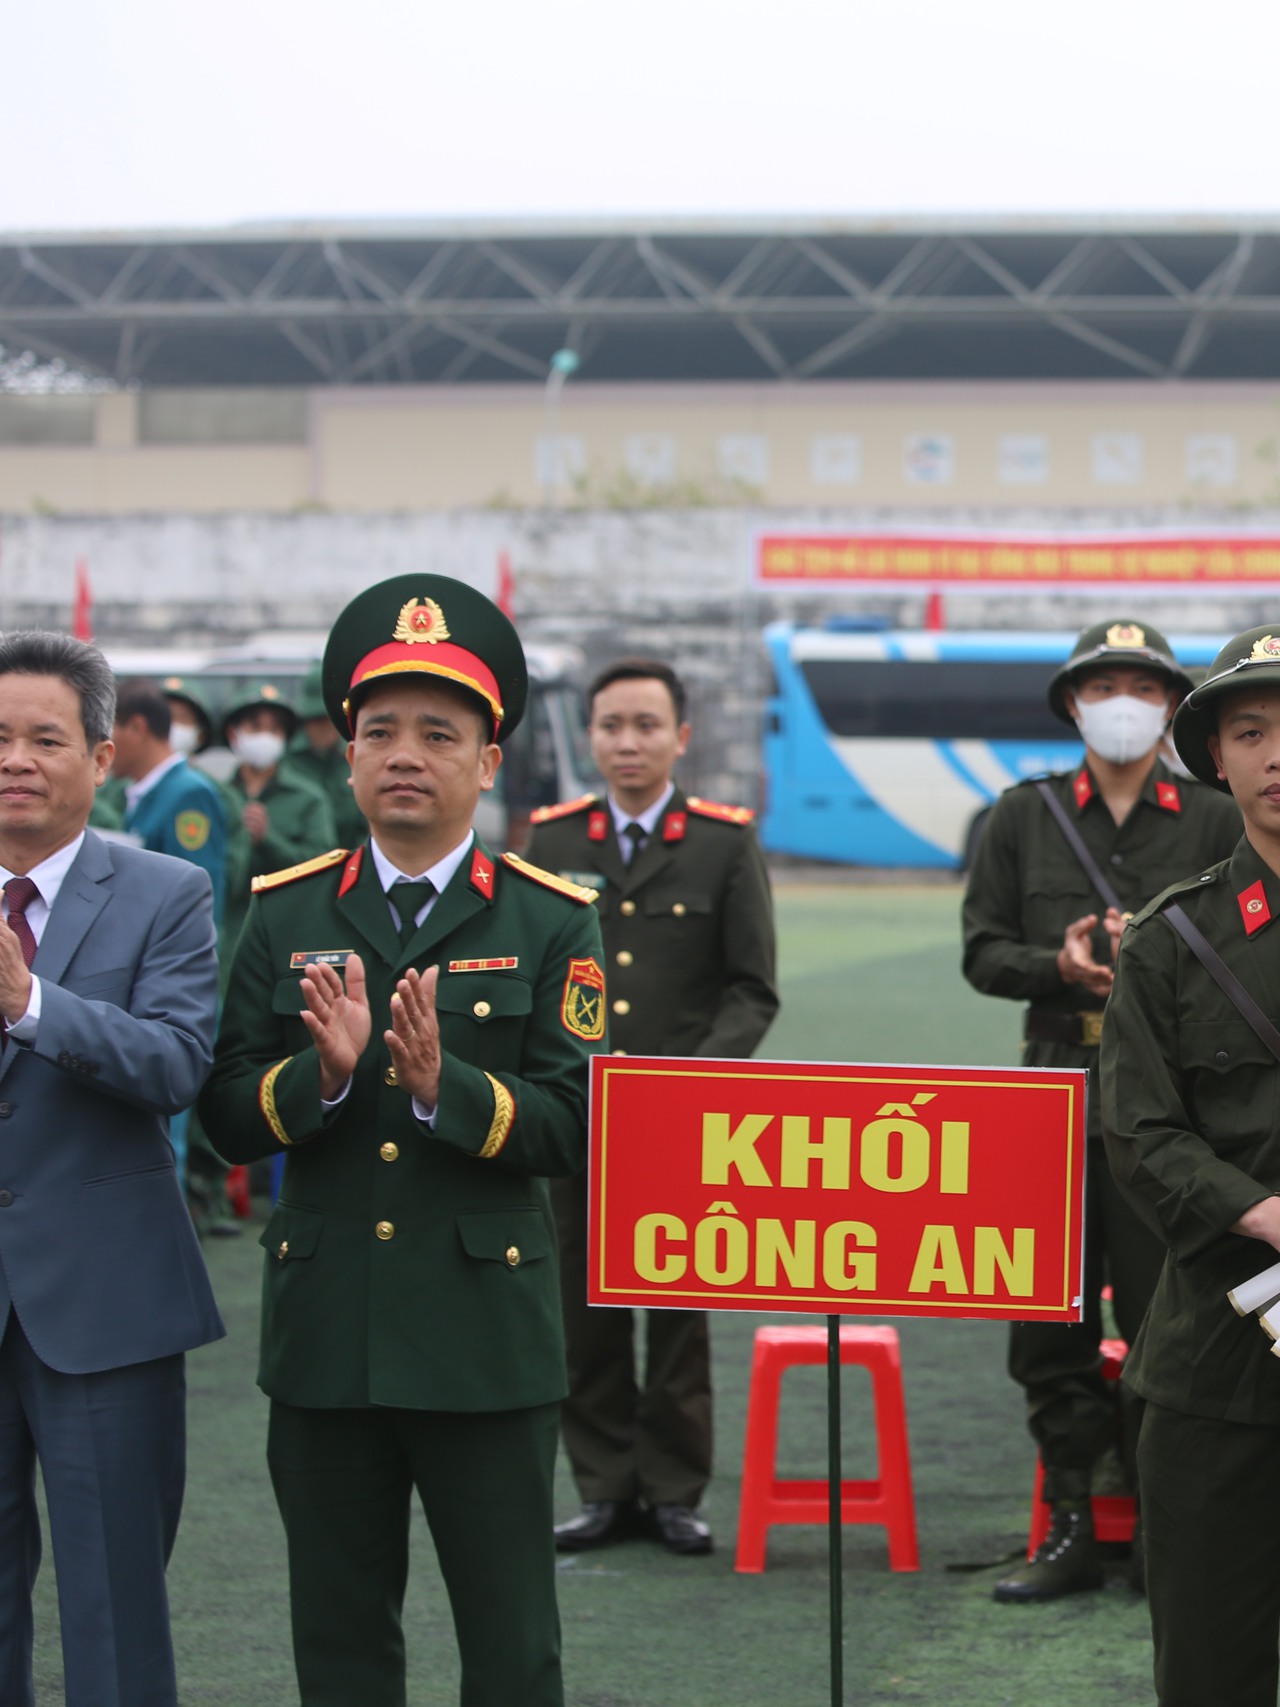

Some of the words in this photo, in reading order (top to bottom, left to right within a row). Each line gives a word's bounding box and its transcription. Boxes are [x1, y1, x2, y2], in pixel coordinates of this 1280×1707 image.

[701, 1092, 970, 1194] KHỐI
[633, 1201, 877, 1291] CÔNG
[908, 1224, 1035, 1297] AN
